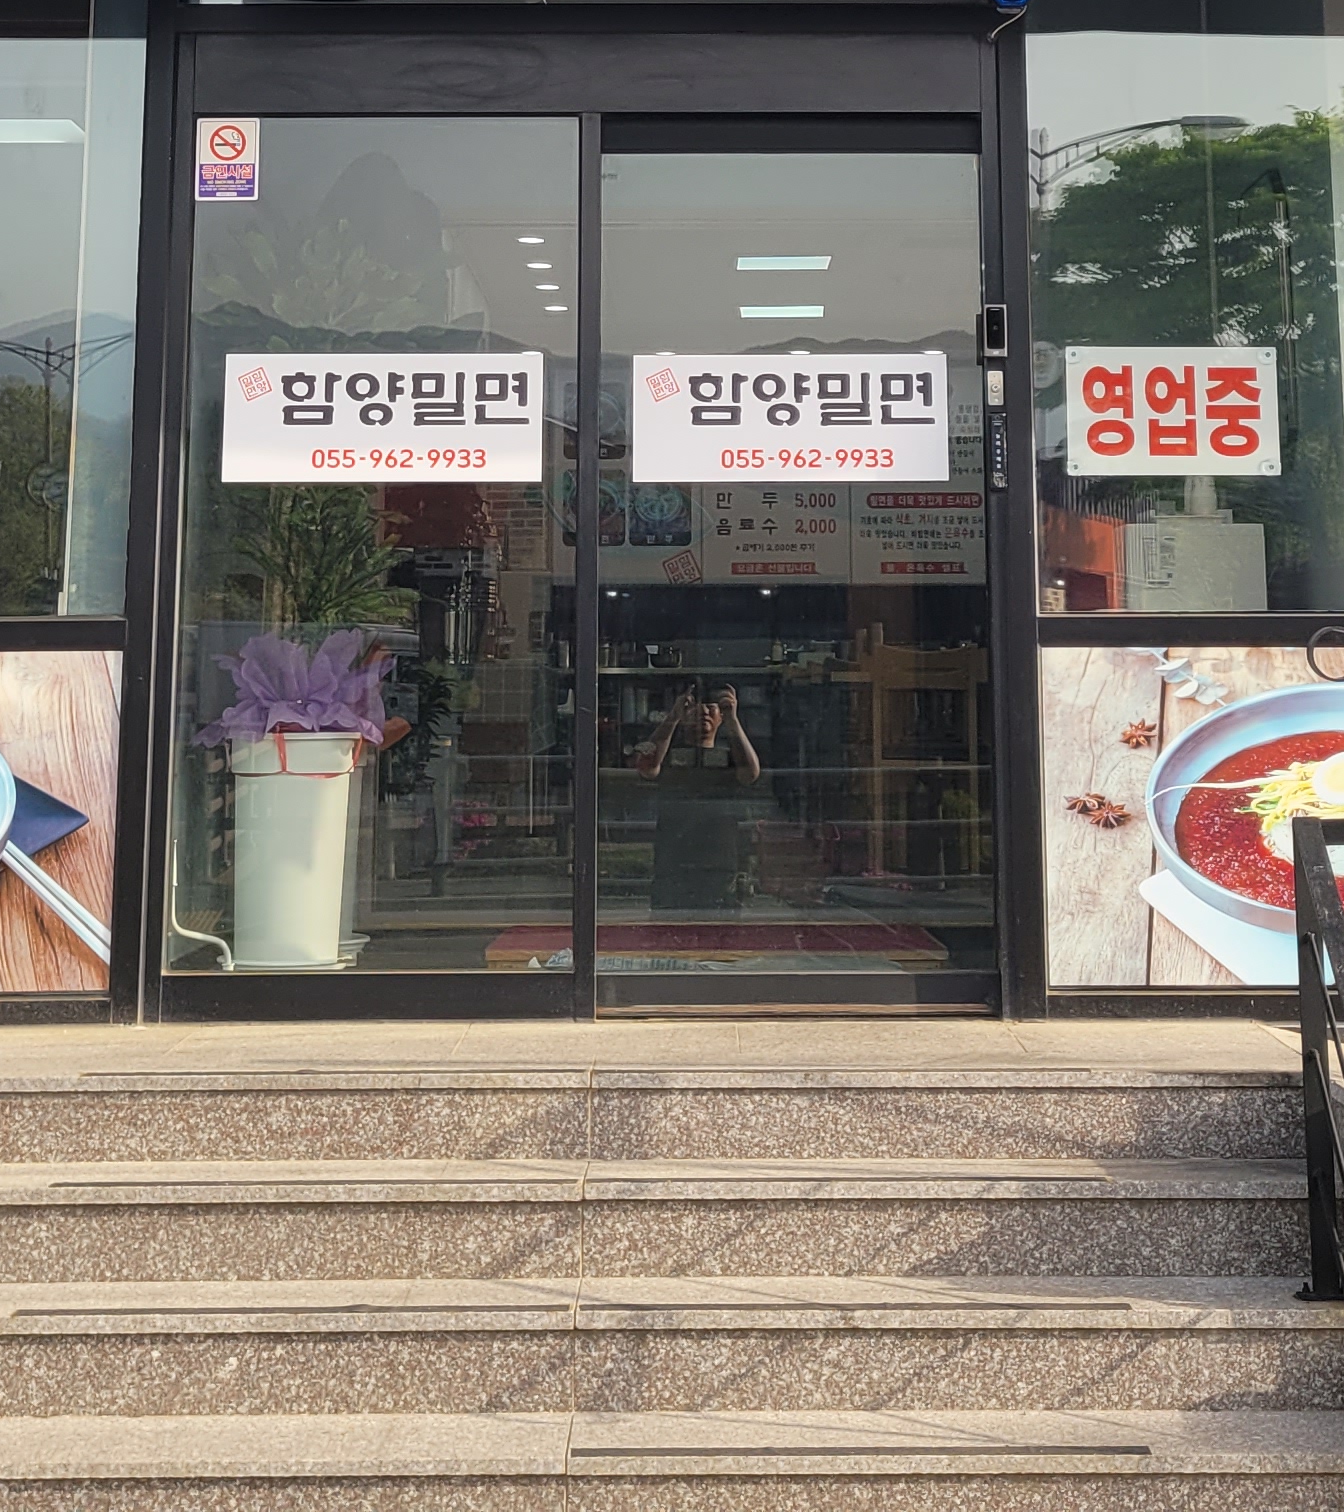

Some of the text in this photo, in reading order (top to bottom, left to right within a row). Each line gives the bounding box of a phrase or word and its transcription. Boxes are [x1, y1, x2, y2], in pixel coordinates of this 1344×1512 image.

[201, 164, 254, 180] 금연시설
[281, 371, 530, 426] 함양밀면
[688, 372, 936, 426] 함양밀면
[1082, 364, 1262, 457] 영업중
[311, 449, 487, 469] 055-962-9933
[721, 449, 895, 469] 055-962-9933
[794, 492, 837, 509] 5,000
[716, 518, 837, 536] 음료수 2,000
